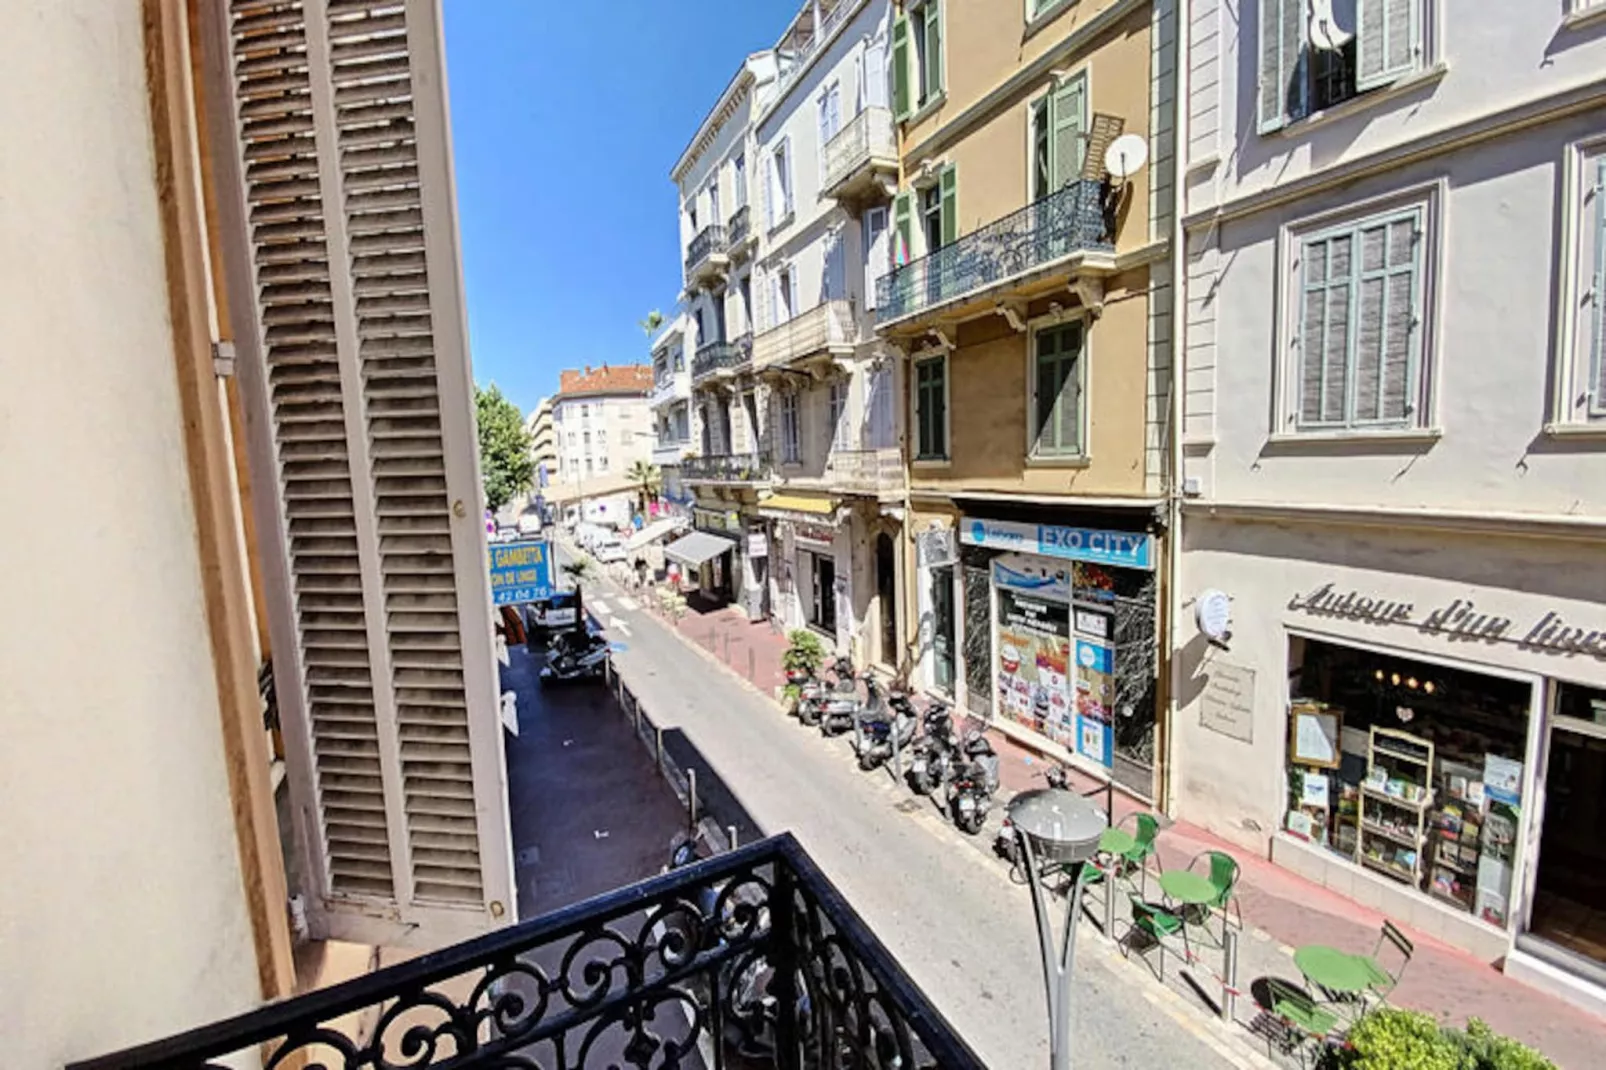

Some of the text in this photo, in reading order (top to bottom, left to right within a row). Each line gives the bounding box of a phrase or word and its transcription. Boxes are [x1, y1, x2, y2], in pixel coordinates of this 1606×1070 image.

[1043, 525, 1083, 548] EXO
[1089, 532, 1142, 556] CITY
[496, 547, 542, 567] GAMBETTA
[515, 589, 531, 600] 04
